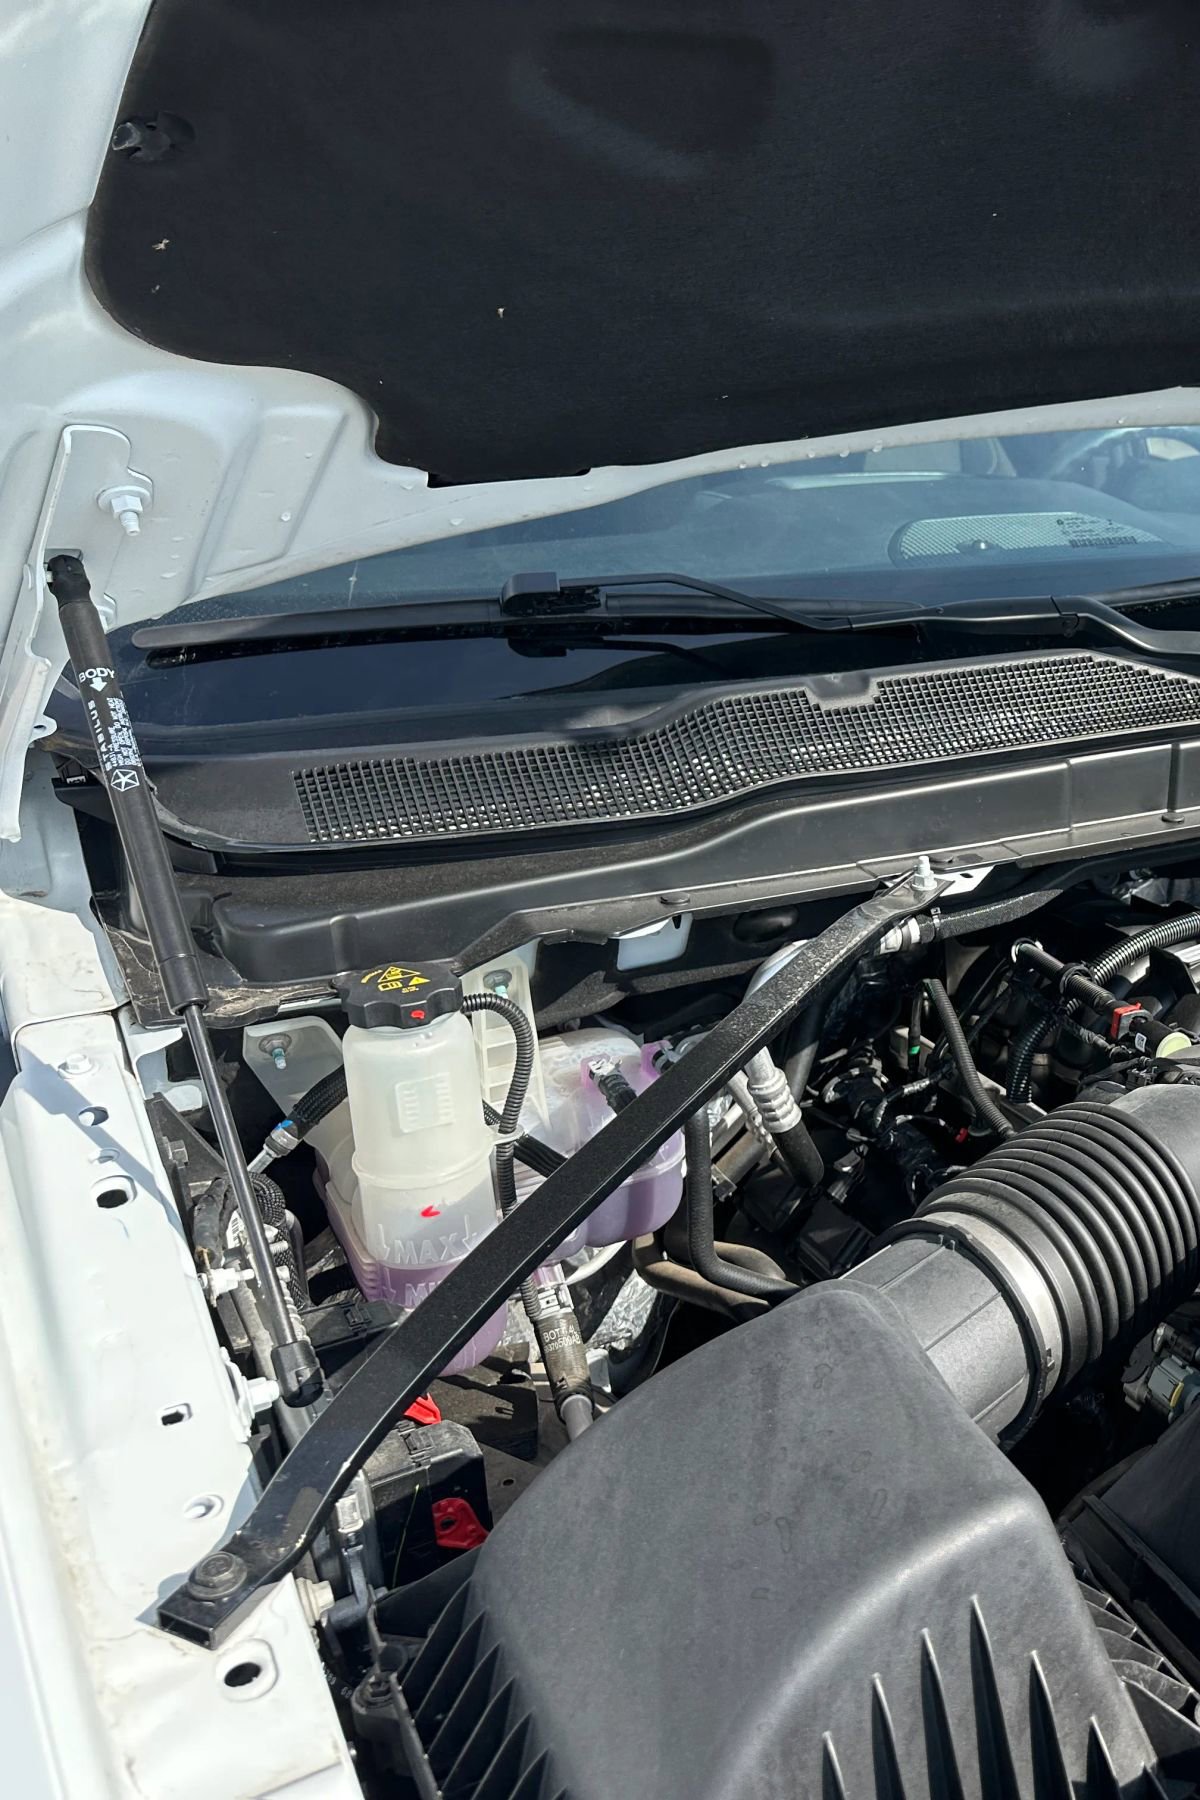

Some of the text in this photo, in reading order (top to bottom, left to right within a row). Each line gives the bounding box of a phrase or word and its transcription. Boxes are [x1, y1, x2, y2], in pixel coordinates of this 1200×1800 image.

[78, 667, 115, 683] BODY
[87, 700, 113, 771] STABILUS
[394, 1233, 458, 1265] MAX
